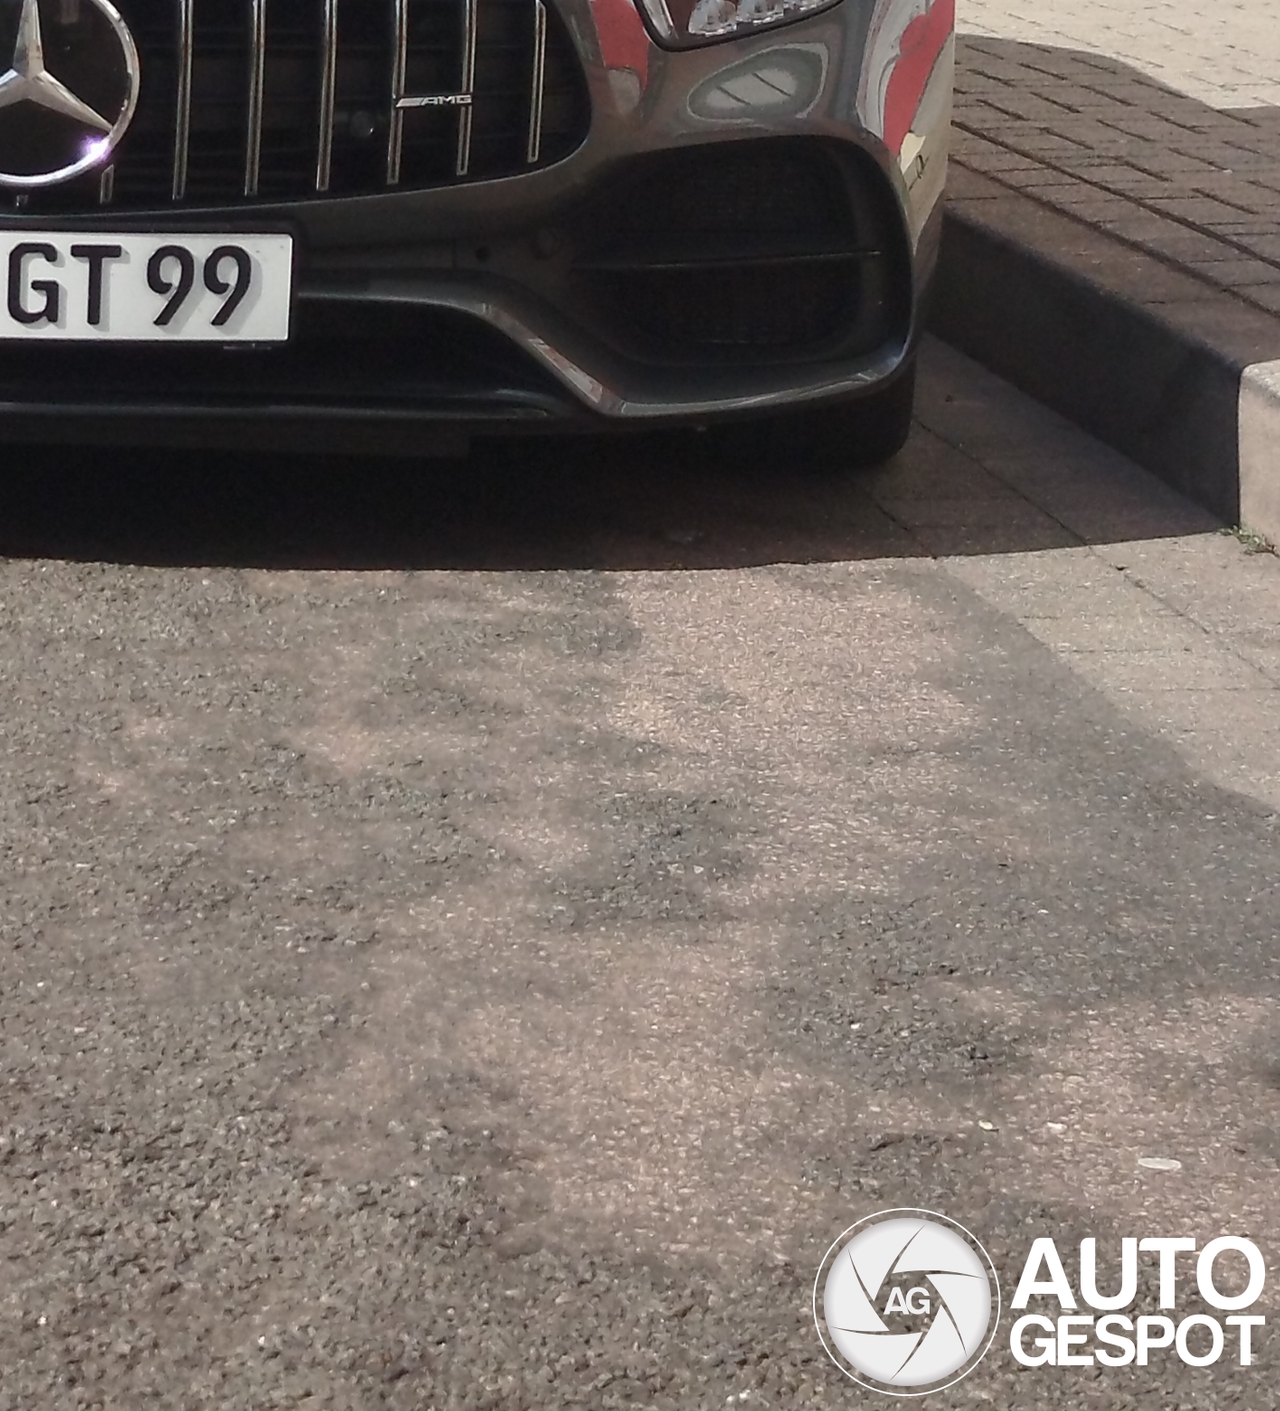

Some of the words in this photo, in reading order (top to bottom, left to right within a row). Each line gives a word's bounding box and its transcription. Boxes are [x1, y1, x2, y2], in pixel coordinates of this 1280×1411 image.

[420, 94, 472, 107] AMG
[7, 243, 122, 325] GT
[147, 245, 252, 326] 99
